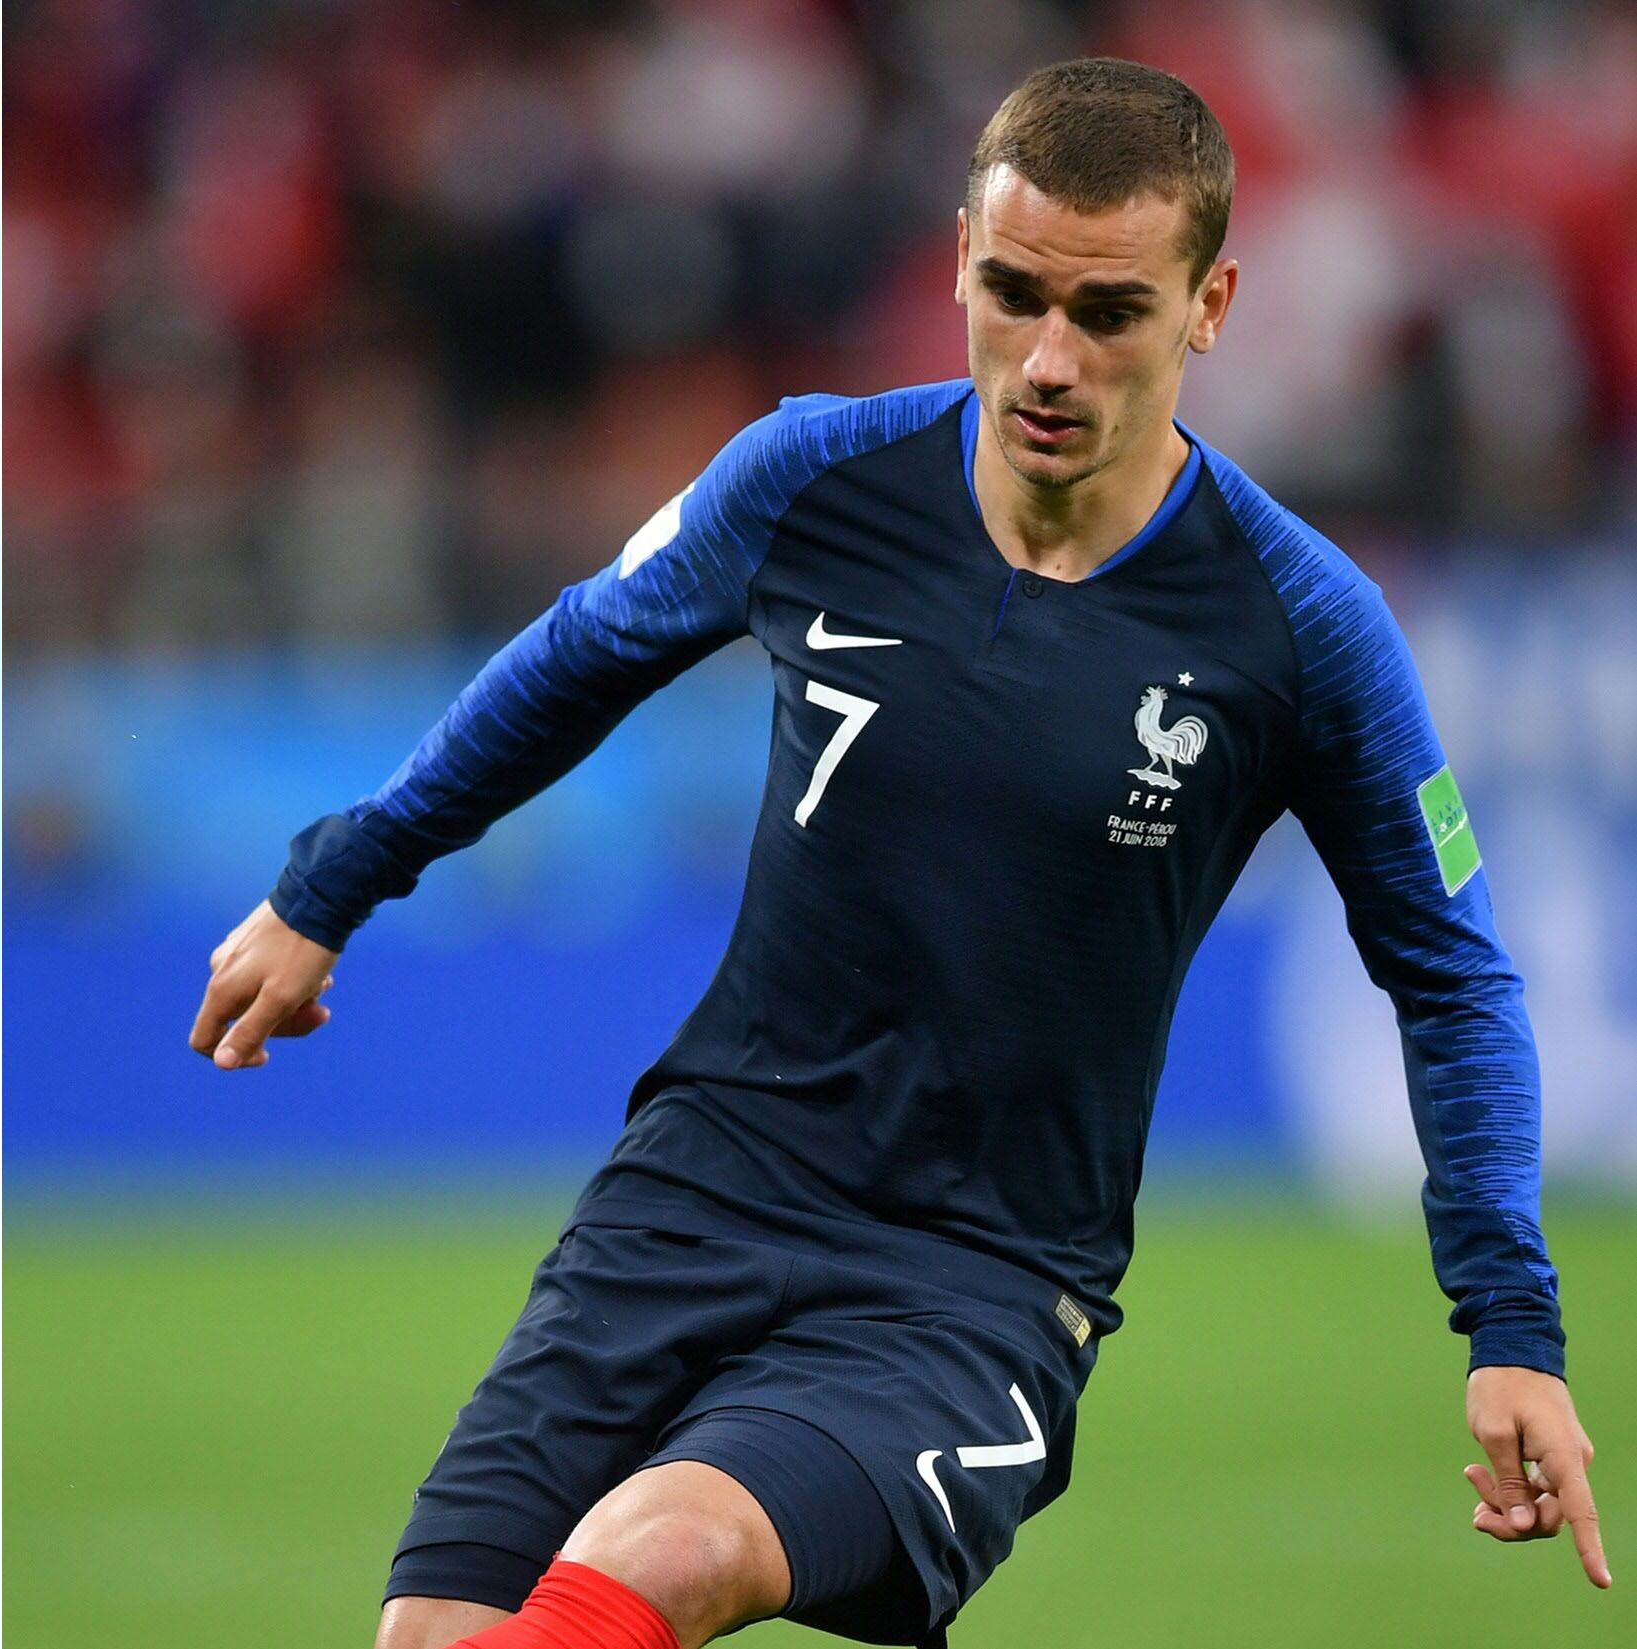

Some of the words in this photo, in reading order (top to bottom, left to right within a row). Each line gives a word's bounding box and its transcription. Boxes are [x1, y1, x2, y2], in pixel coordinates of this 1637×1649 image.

[794, 680, 881, 828] 7
[1108, 829, 1122, 844] 21
[1143, 835, 1168, 847] 2018
[955, 1382, 1047, 1469] 7
